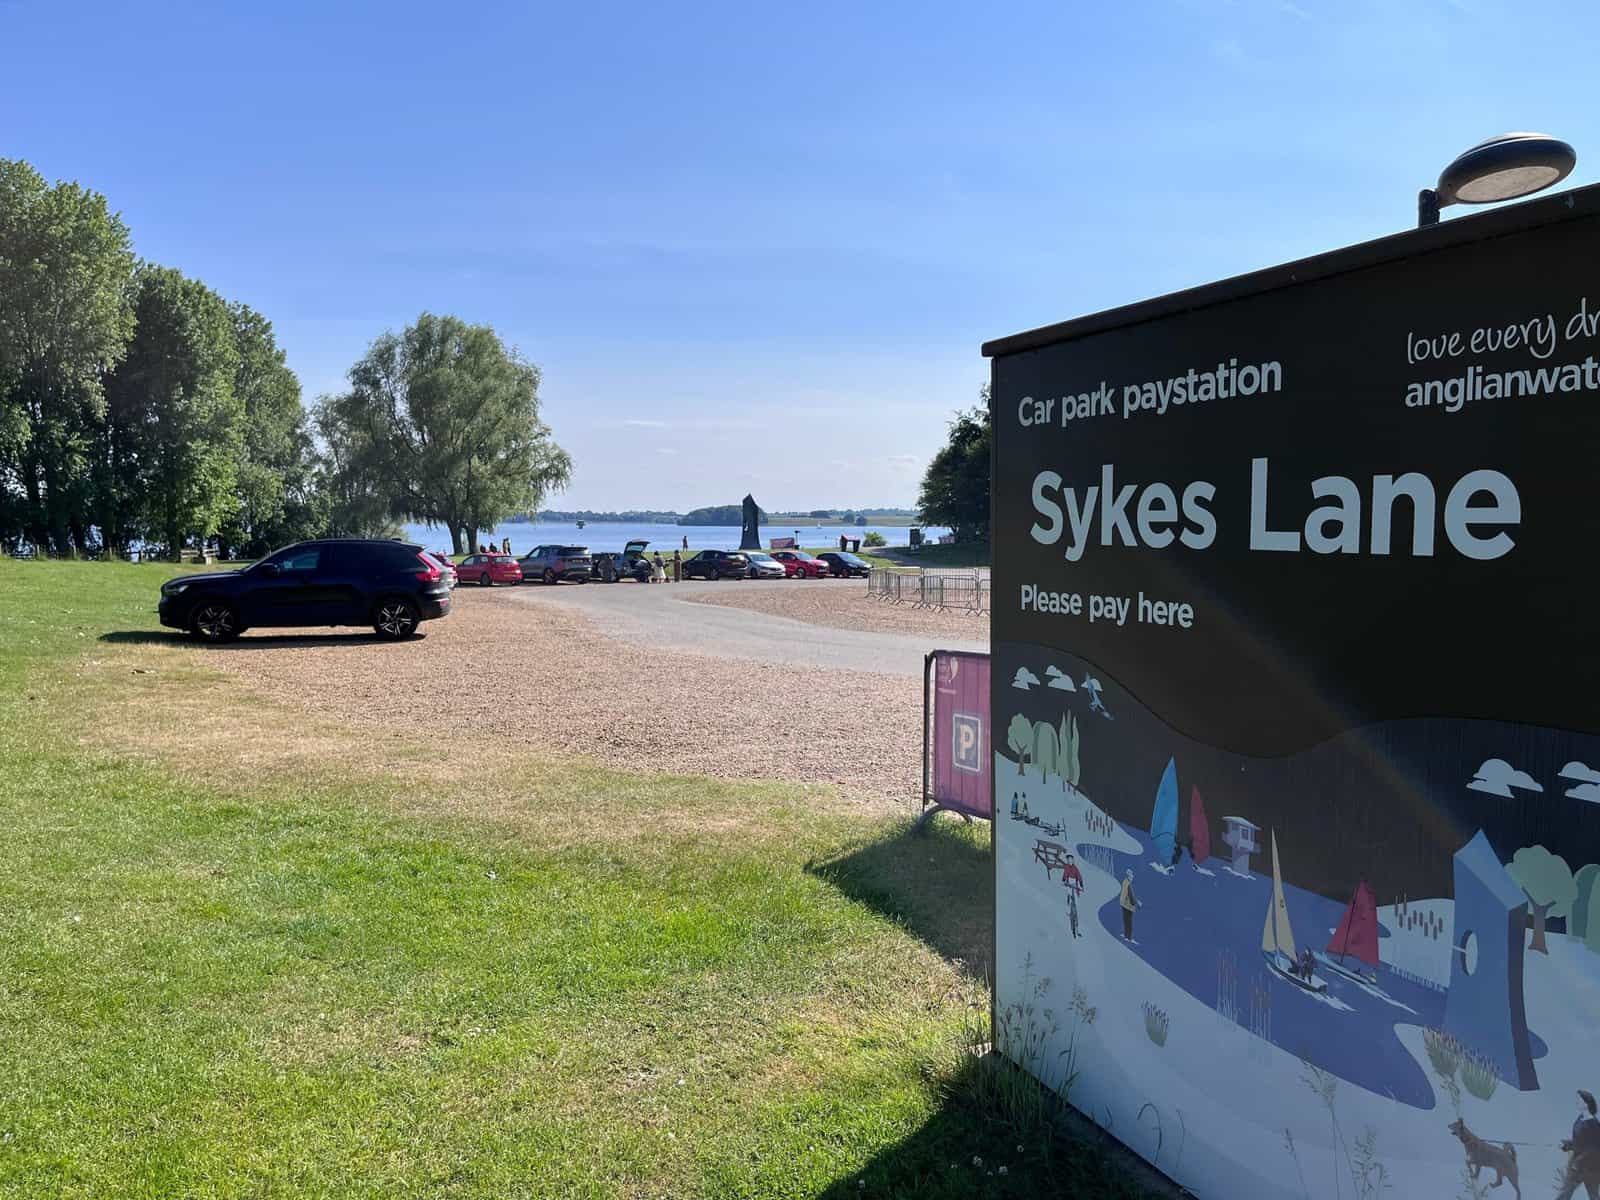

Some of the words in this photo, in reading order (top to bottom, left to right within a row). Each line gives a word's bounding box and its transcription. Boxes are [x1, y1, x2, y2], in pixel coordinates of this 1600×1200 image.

[1407, 332, 1465, 365] love
[1470, 314, 1556, 359] every
[1018, 396, 1055, 427] Car
[1061, 381, 1116, 428] park
[1123, 358, 1282, 420] paystation
[1405, 356, 1600, 413] anglianwat
[1030, 463, 1217, 562] Sykes
[1249, 457, 1522, 560] Lane
[1020, 583, 1083, 616] Please
[1089, 594, 1131, 627] pay
[1137, 591, 1194, 629] here
[959, 723, 975, 761] P
